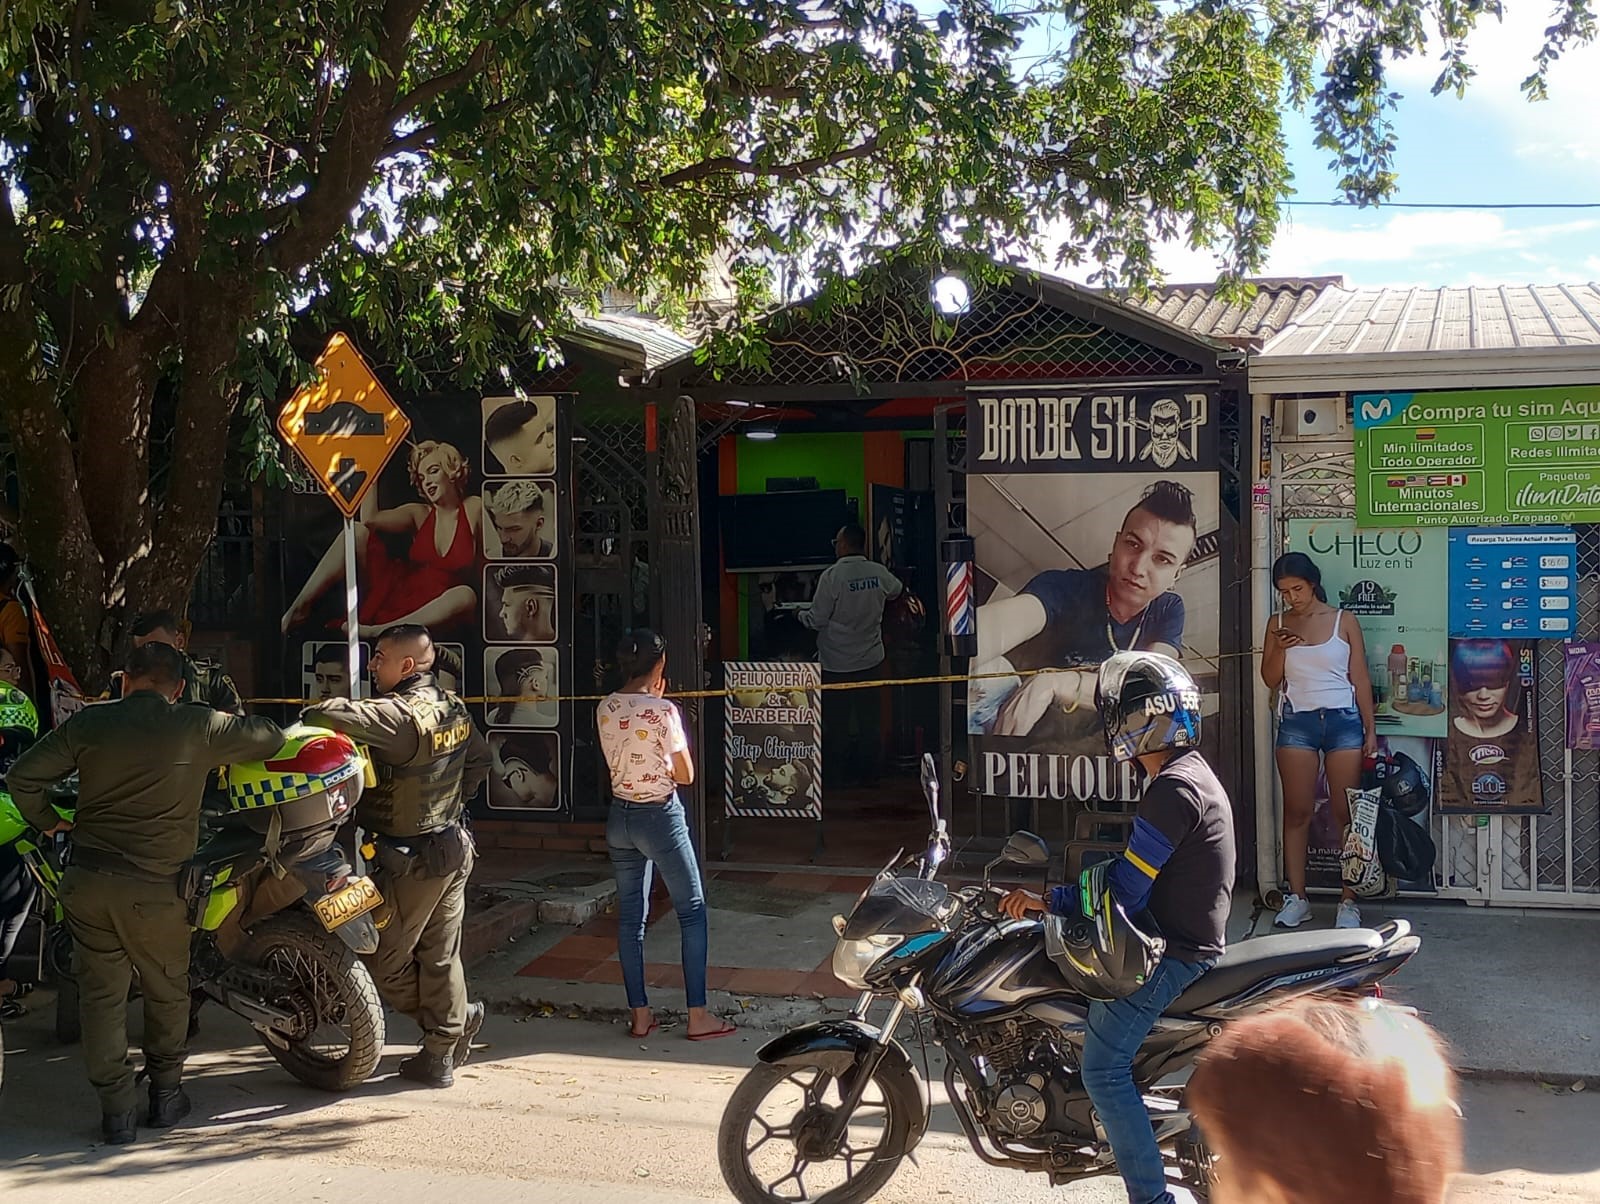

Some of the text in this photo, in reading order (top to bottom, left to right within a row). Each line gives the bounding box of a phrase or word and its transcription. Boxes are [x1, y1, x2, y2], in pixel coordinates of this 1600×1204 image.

[1402, 403, 1486, 424] ¡Compra
[1492, 402, 1512, 418] tu
[1518, 401, 1554, 417] sim
[977, 396, 1082, 464] BARBE
[1091, 394, 1208, 463] SHP
[1383, 443, 1406, 453] Min
[1511, 447, 1552, 459] Redes
[1380, 455, 1477, 468] Todo Operador
[1540, 472, 1591, 482] Paquetes
[1399, 487, 1454, 499] Minutos
[1374, 499, 1479, 513] Internacionales
[1417, 513, 1558, 525] Punto Autorizado Prepago
[1360, 557, 1413, 568] Luz en ti
[849, 576, 879, 592] SIJIN
[1360, 582, 1375, 594] 19
[1358, 593, 1376, 602] FREE
[1516, 648, 1534, 687] gloss
[731, 669, 814, 688] PELUQUERÍA
[768, 695, 782, 706] &
[1145, 693, 1176, 717] ASU
[732, 706, 816, 723] BARBERÍA
[982, 751, 1149, 803] PELUQUE
[1472, 782, 1506, 793] BLUE
[1307, 846, 1317, 855] La
